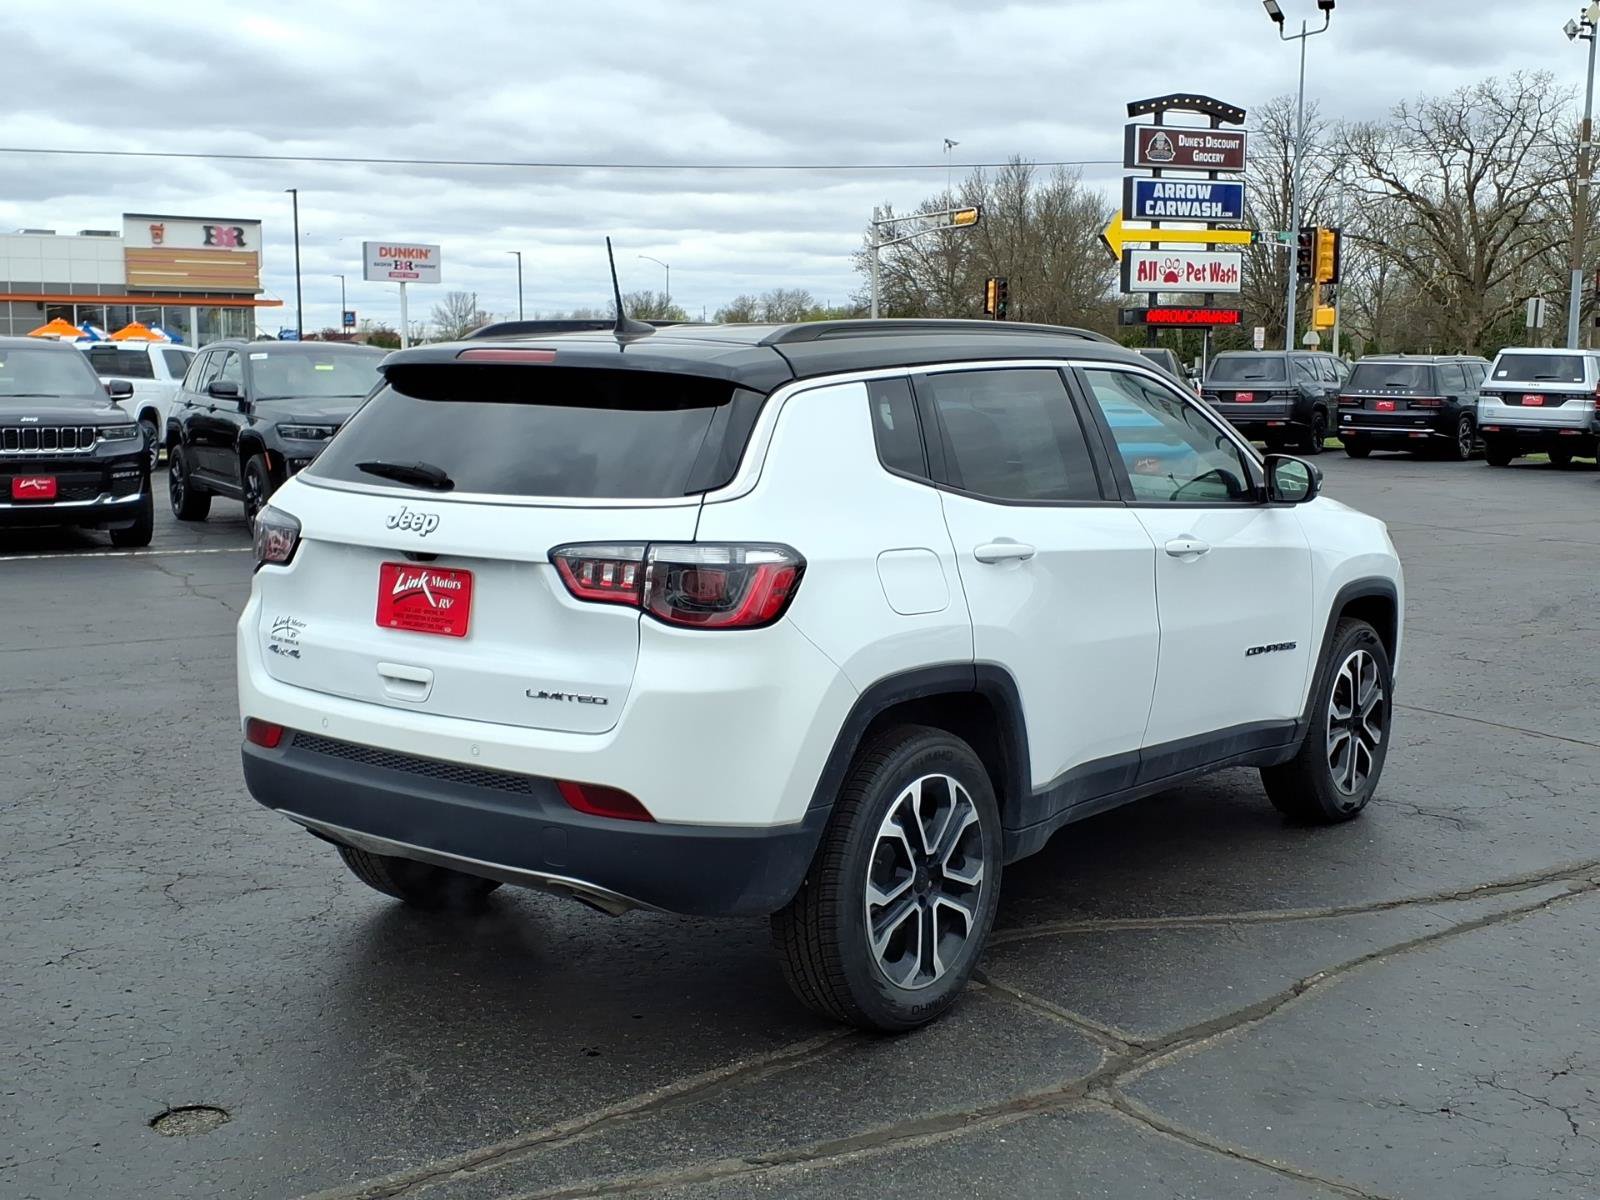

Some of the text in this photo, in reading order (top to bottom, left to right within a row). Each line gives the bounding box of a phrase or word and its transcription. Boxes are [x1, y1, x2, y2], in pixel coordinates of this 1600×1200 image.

[1178, 134, 1240, 149] DUKE'S DISCOUNT
[1192, 150, 1225, 163] GROCERY
[1153, 183, 1212, 199] ARROW
[379, 246, 431, 260] DUNKIN'
[1137, 260, 1238, 283] All Pet Wash
[386, 506, 440, 537] Jeep
[392, 571, 462, 608] Link Motors
[438, 598, 455, 609] RV
[1245, 641, 1297, 656] COMPASS
[526, 689, 608, 706] LIMITED
